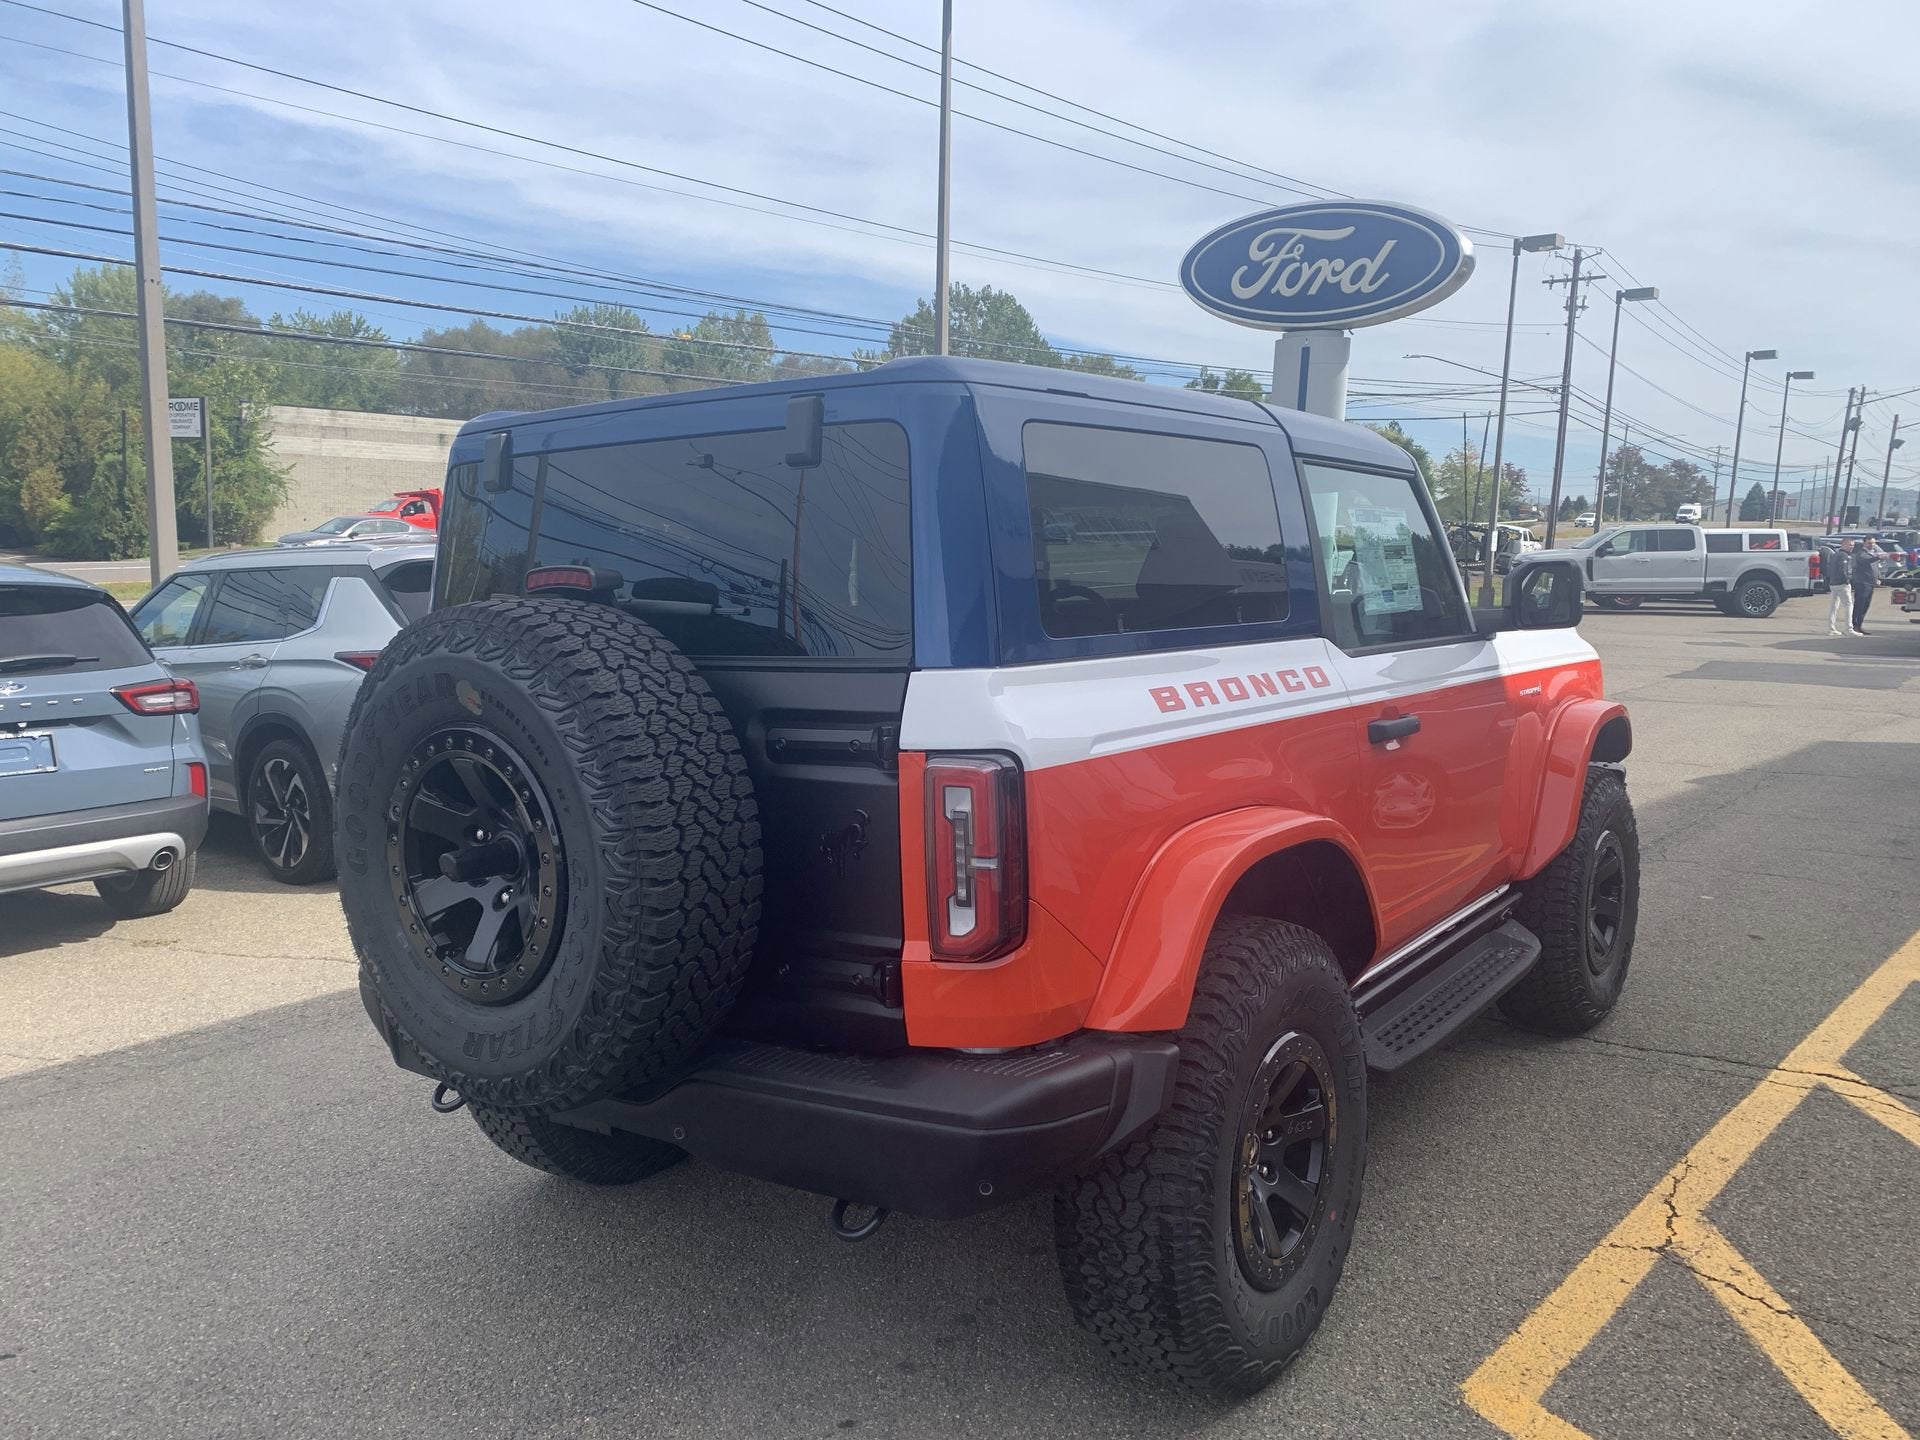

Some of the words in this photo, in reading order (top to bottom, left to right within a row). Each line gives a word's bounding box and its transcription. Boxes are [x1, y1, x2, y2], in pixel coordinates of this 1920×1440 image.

[1231, 226, 1398, 300] Ford
[168, 401, 199, 411] ROOME
[1148, 666, 1331, 713] BRONCO
